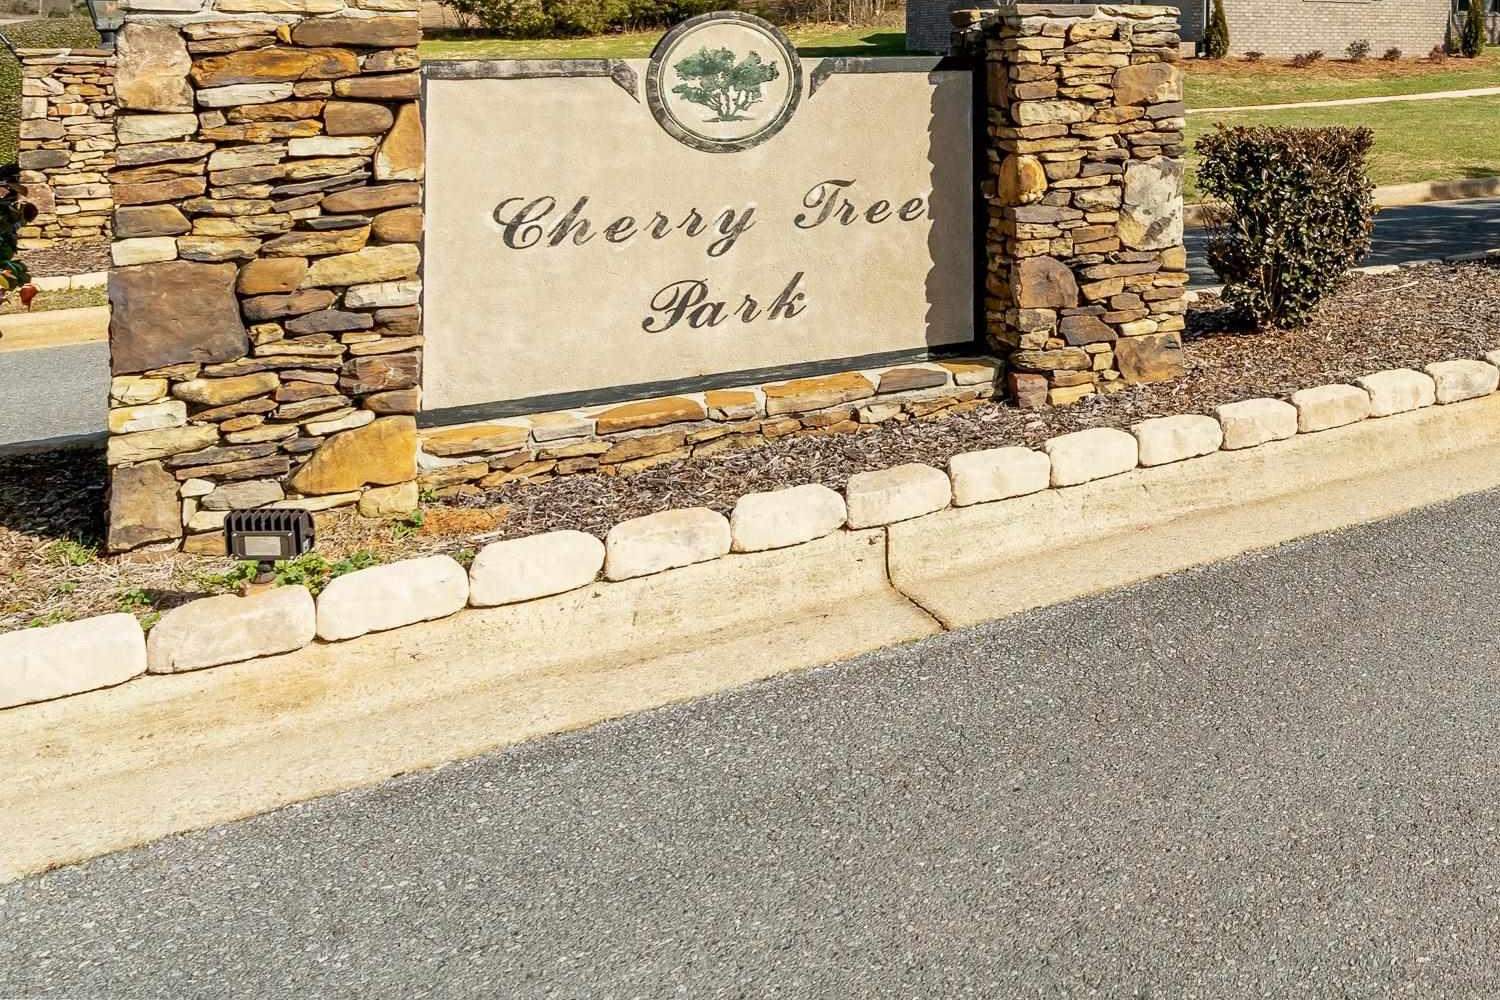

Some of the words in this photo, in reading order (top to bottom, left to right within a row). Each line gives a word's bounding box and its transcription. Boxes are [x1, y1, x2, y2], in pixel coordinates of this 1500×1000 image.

[491, 195, 756, 258] Cherry
[793, 178, 927, 230] Tree
[641, 271, 808, 334] Park
